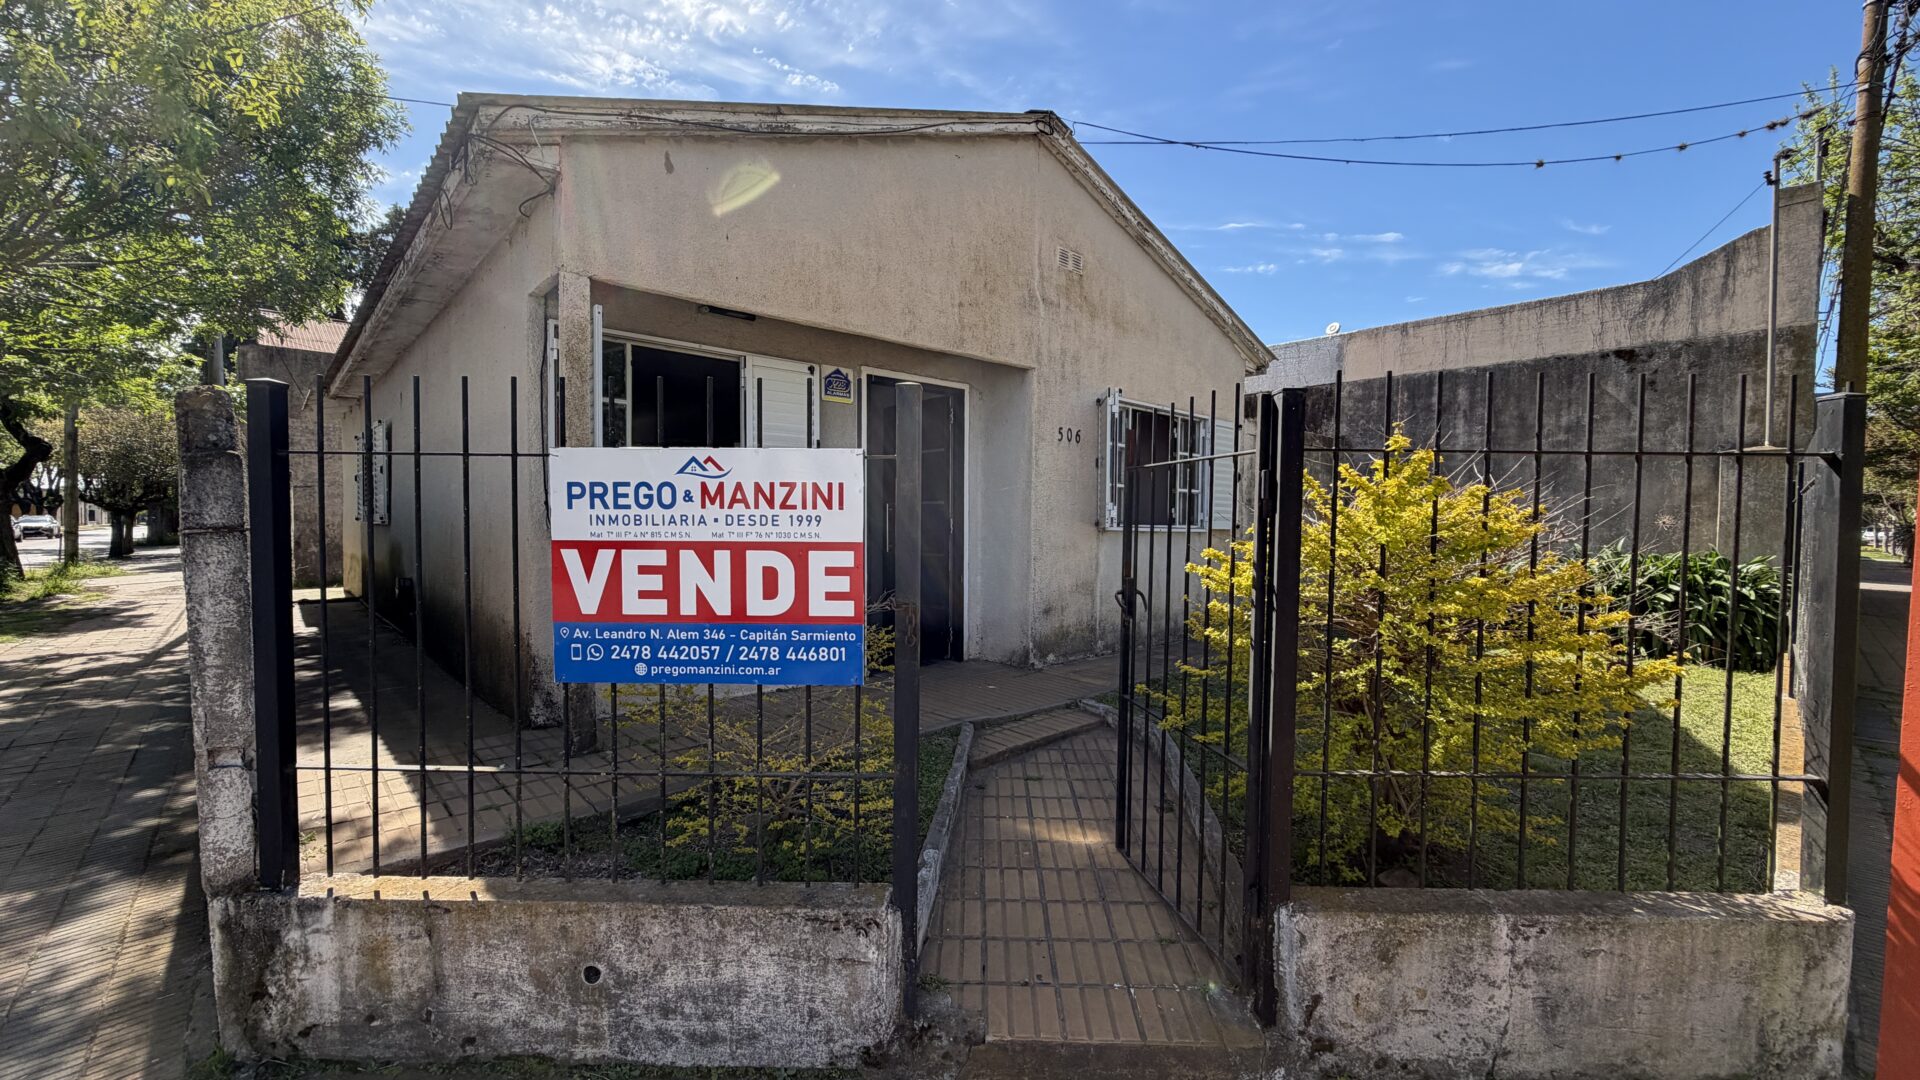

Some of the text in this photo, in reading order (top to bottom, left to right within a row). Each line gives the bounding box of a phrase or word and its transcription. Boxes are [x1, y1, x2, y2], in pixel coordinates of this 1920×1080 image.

[1057, 427, 1081, 444] 506
[566, 481, 844, 511] PREGO & MANZINI
[589, 514, 822, 527] INMOBILIARIA DESDE 1999
[650, 531, 662, 539] 815
[560, 548, 855, 617] VENDE
[573, 628, 591, 639] Av.
[595, 628, 646, 640] Leandro
[650, 629, 663, 640] N.
[667, 629, 699, 640] Alem
[703, 629, 726, 640] 346
[740, 629, 787, 643] Capitán
[791, 630, 856, 641] Sarmiento
[611, 645, 846, 663] 2478 442057 / 2478 446801
[651, 664, 781, 677] pregomanzini.com.ar
